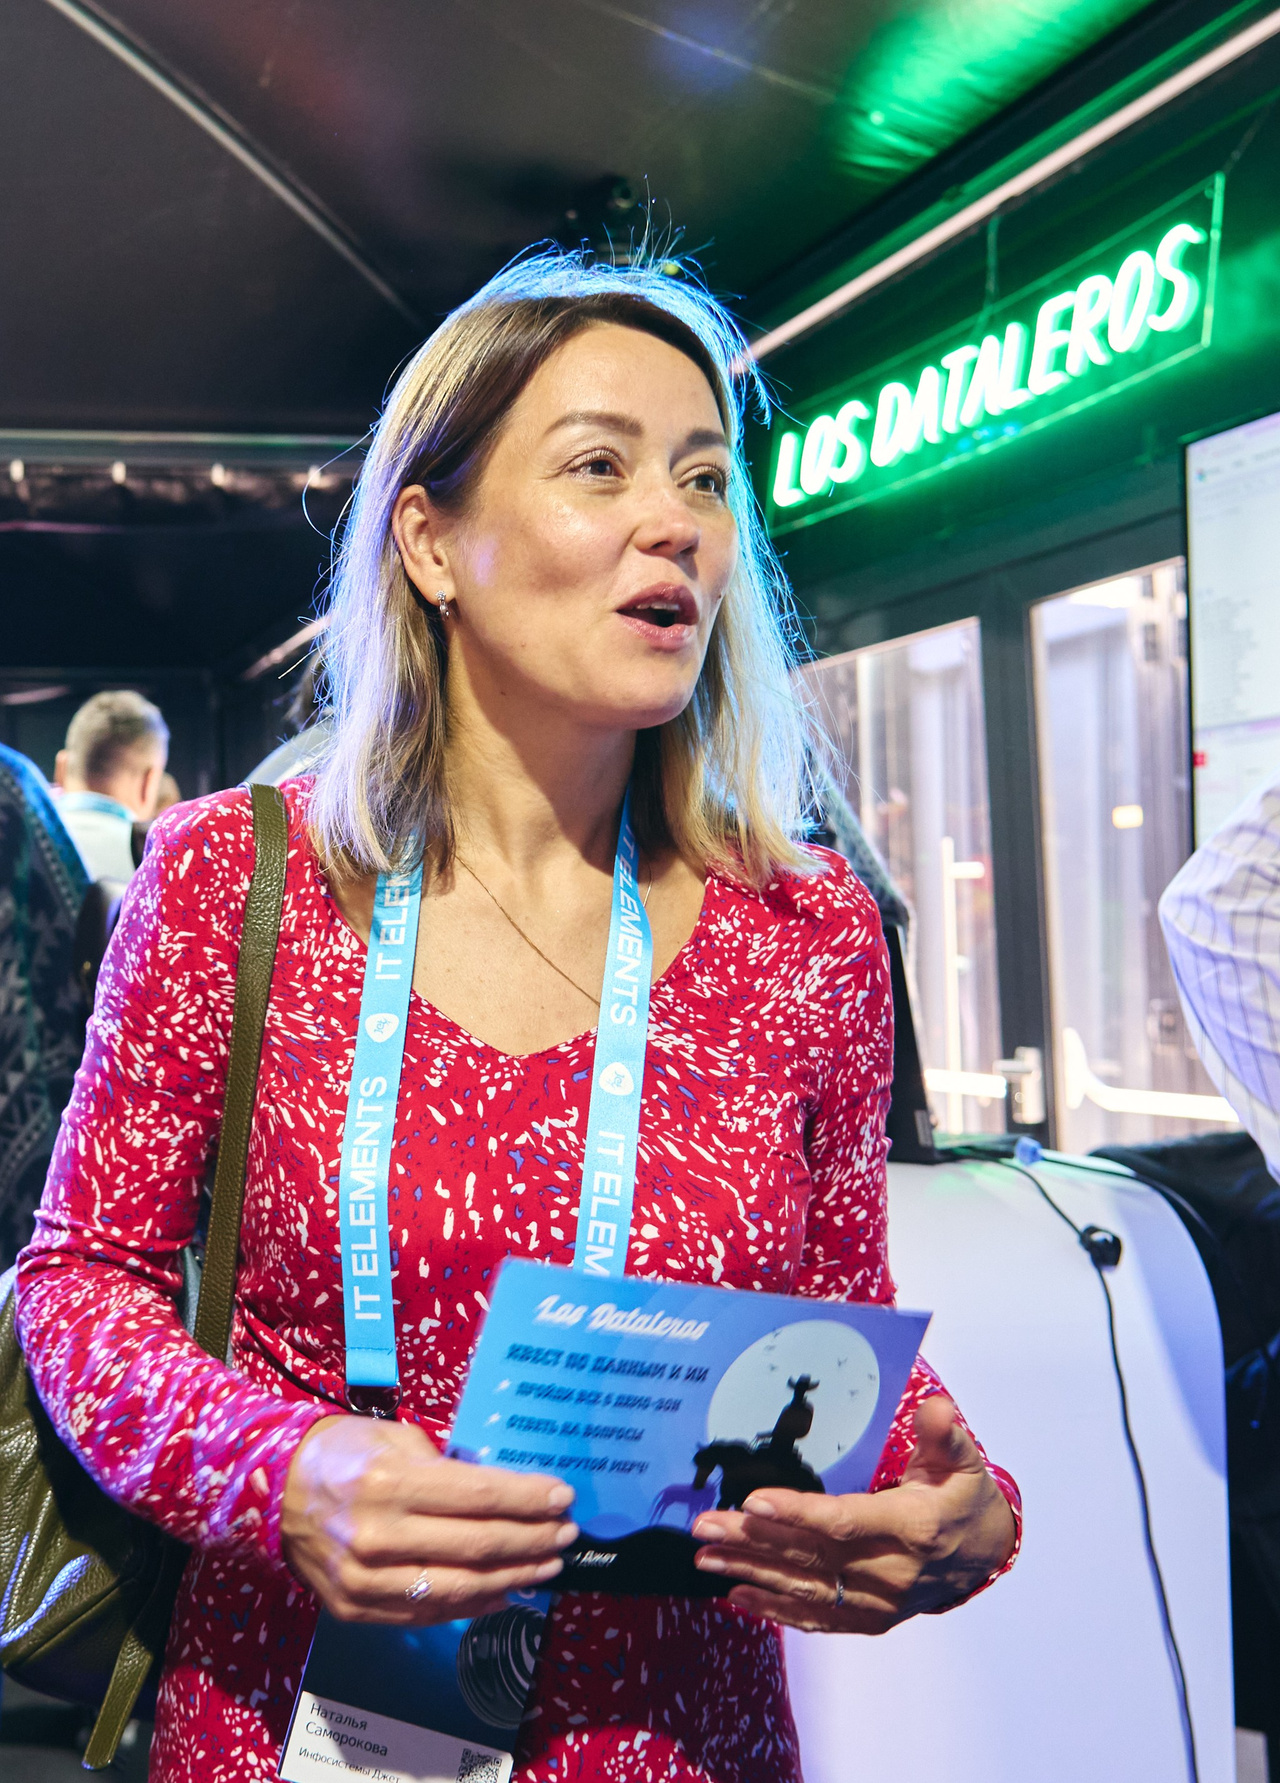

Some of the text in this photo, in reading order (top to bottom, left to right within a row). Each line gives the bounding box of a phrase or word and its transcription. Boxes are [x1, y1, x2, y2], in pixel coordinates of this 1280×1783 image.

[773, 223, 1207, 508] LOS DATALEROS
[609, 824, 643, 1027] IT ELEMENTS
[375, 952, 403, 980] IT
[349, 1075, 388, 1320] IT ELEMENTS
[583, 1130, 627, 1277] IT ELEM
[506, 1343, 564, 1367] КВЕСТ
[590, 1355, 670, 1379] ДАННЫМ
[667, 1363, 683, 1381] И
[683, 1366, 710, 1383] ИИ
[310, 1703, 368, 1731] Наталья
[306, 1721, 388, 1757] Саморокова
[299, 1746, 371, 1776] Инфосистемы
